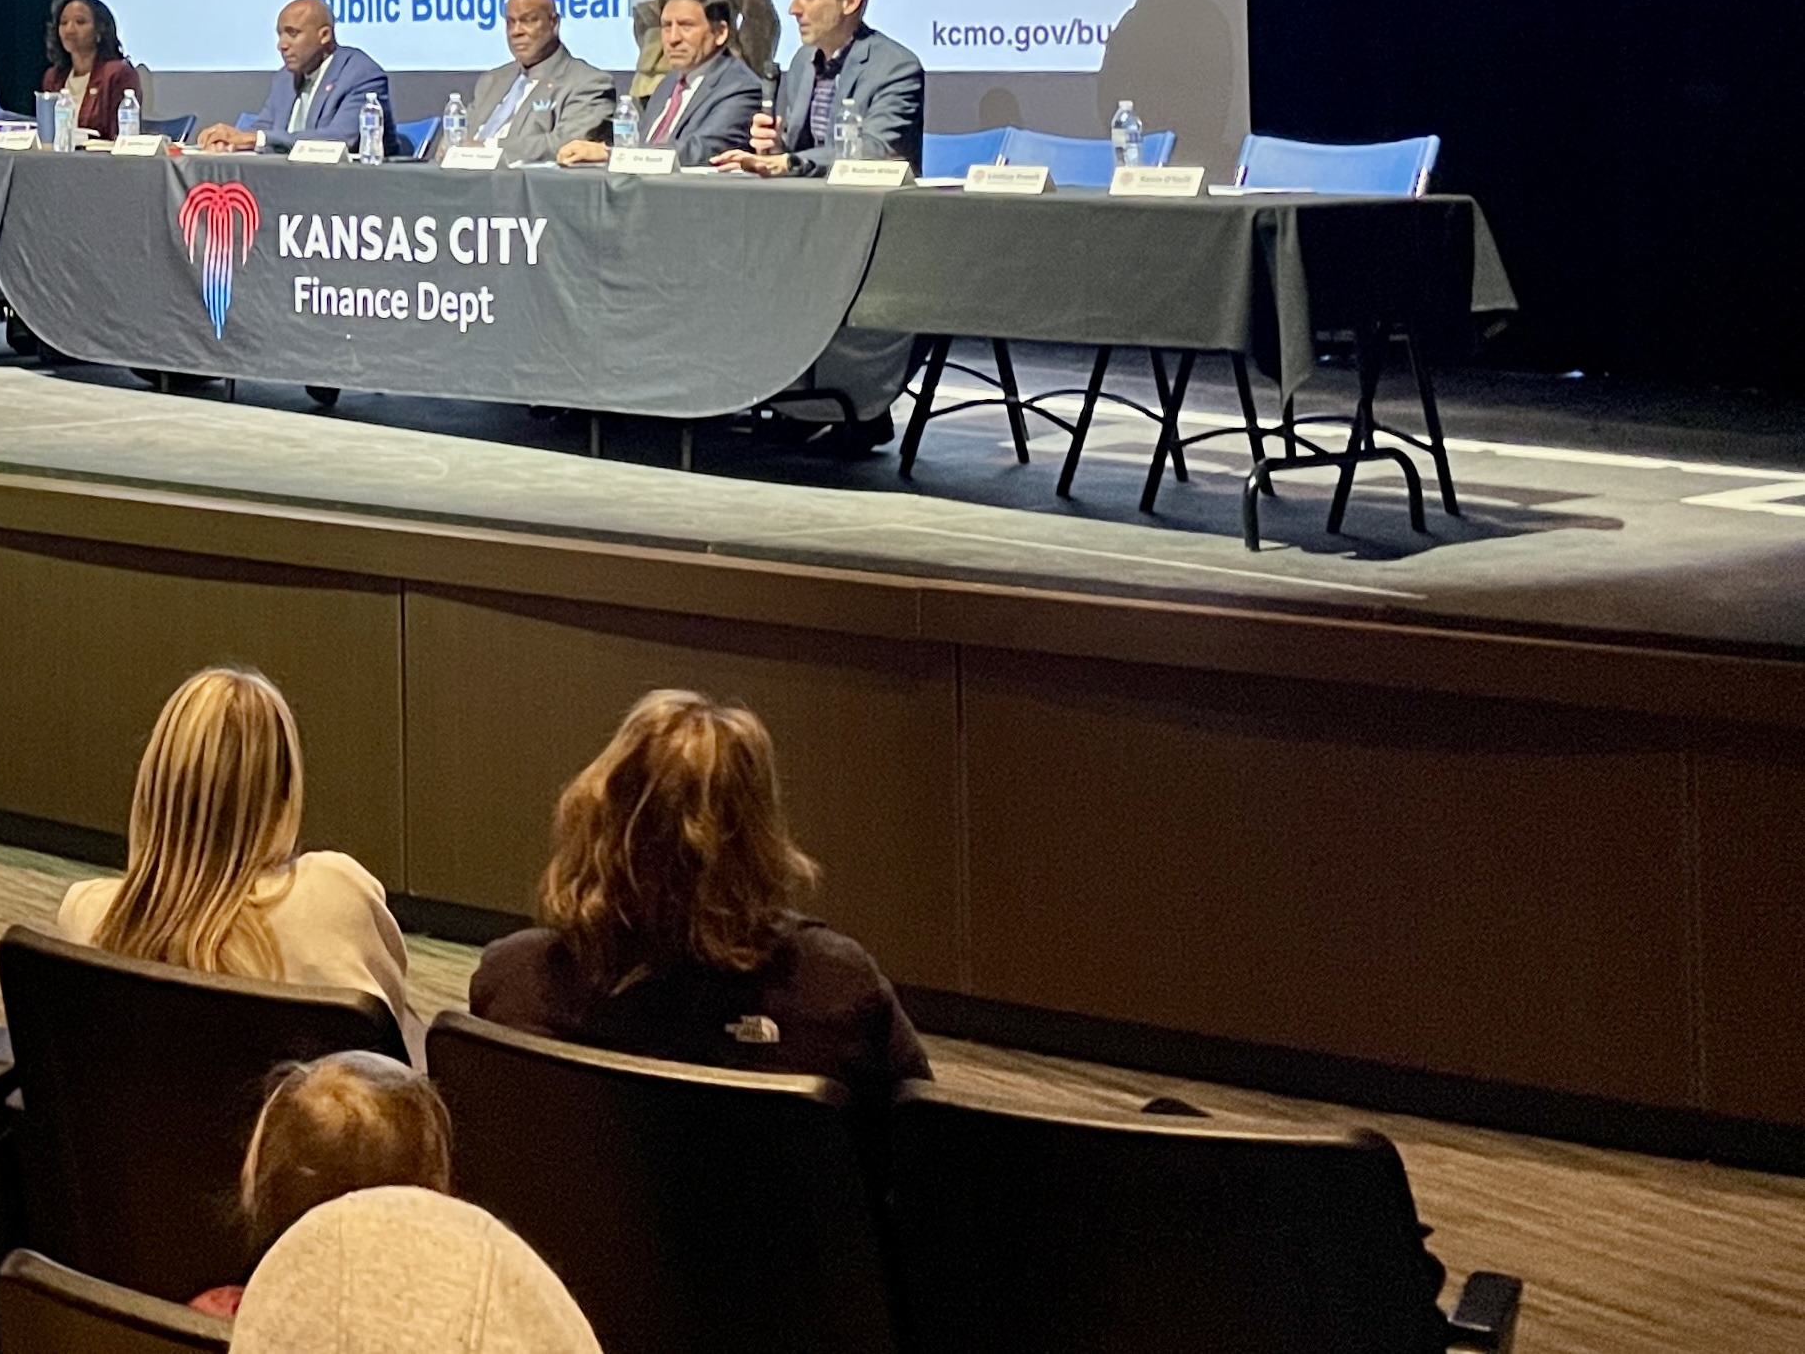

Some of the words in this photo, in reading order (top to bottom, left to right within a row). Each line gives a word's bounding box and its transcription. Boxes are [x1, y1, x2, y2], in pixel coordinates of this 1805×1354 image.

[932, 17, 1112, 52] kcmo.gov/bu
[278, 213, 439, 263] KANSAS
[449, 216, 548, 265] CITY
[293, 276, 409, 319] Finance
[416, 280, 495, 333] Dept
